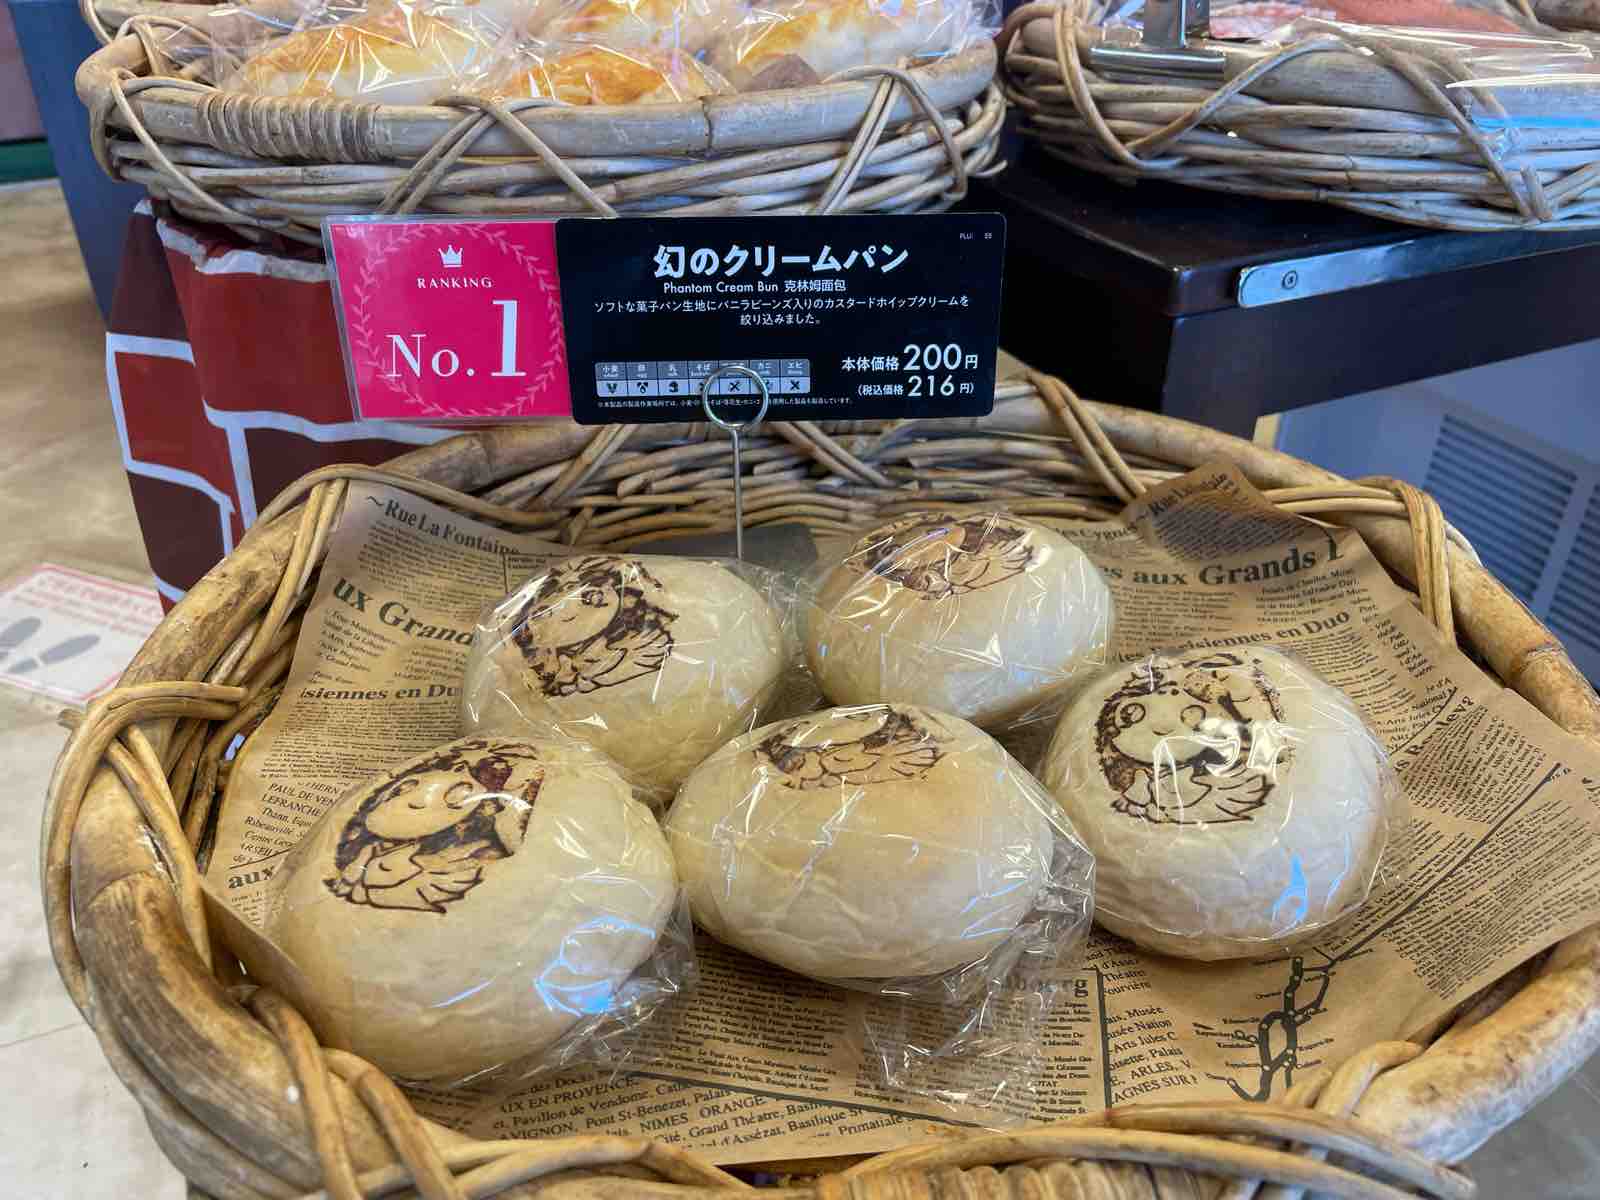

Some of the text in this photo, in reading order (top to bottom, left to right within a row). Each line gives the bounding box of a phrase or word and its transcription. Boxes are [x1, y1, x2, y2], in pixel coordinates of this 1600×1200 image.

[653, 244, 909, 279] 幻のクリームパン
[417, 276, 493, 289] RANKING
[663, 279, 847, 294] Phantom Cream Bun 克林姆面包
[740, 313, 822, 327] 絞り込みました。
[1132, 570, 1189, 585] aux
[1199, 547, 1317, 586] Grands
[1275, 627, 1301, 641] en
[1302, 610, 1350, 634] Duo
[395, 687, 422, 700] en
[269, 782, 297, 799] PAUL
[298, 790, 315, 803] DE
[528, 1096, 549, 1110] EN
[512, 1109, 568, 1128] Pavillon
[569, 1105, 585, 1117] de
[585, 1115, 615, 1129] Pont
[640, 1111, 690, 1133] NIMES
[699, 1094, 767, 1119] ORANGE
[688, 1119, 729, 1139] Grand
